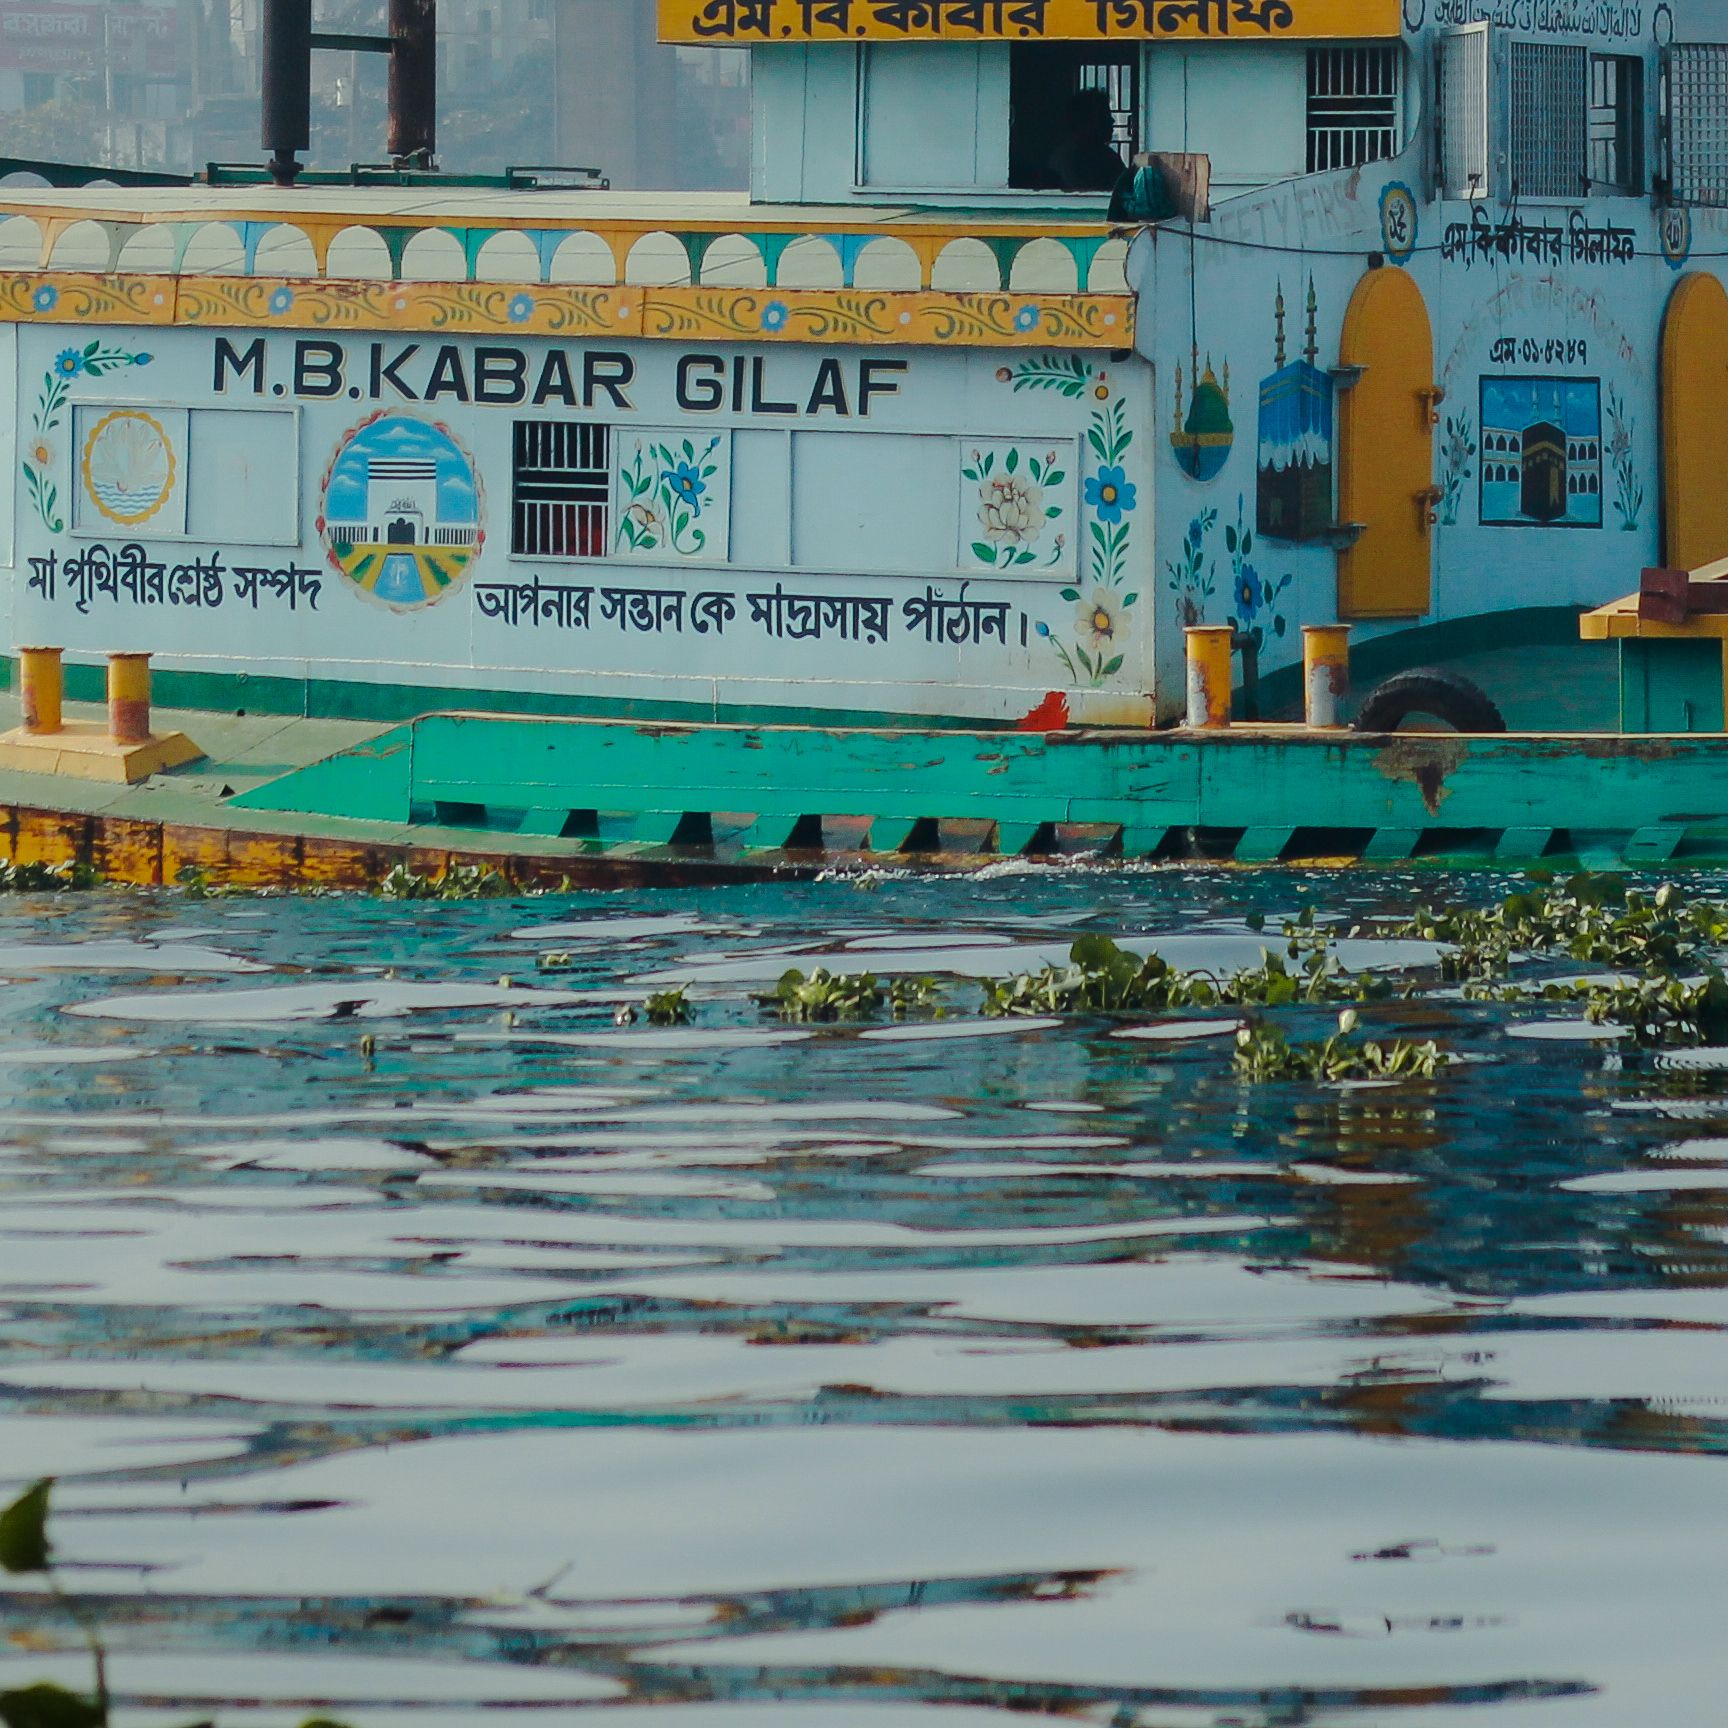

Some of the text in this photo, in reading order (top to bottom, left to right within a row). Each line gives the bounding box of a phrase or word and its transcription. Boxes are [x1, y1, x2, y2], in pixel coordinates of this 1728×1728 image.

[1569, 210, 1636, 265] গিলাফ
[213, 336, 908, 418] M.B.KABAR GILAF
[29, 546, 323, 614] মা পৃথিবীর শ্রেষ্ঠ সম্পদ
[475, 574, 594, 629] আপনার
[601, 584, 684, 636] সন্তান
[691, 588, 735, 634] কে
